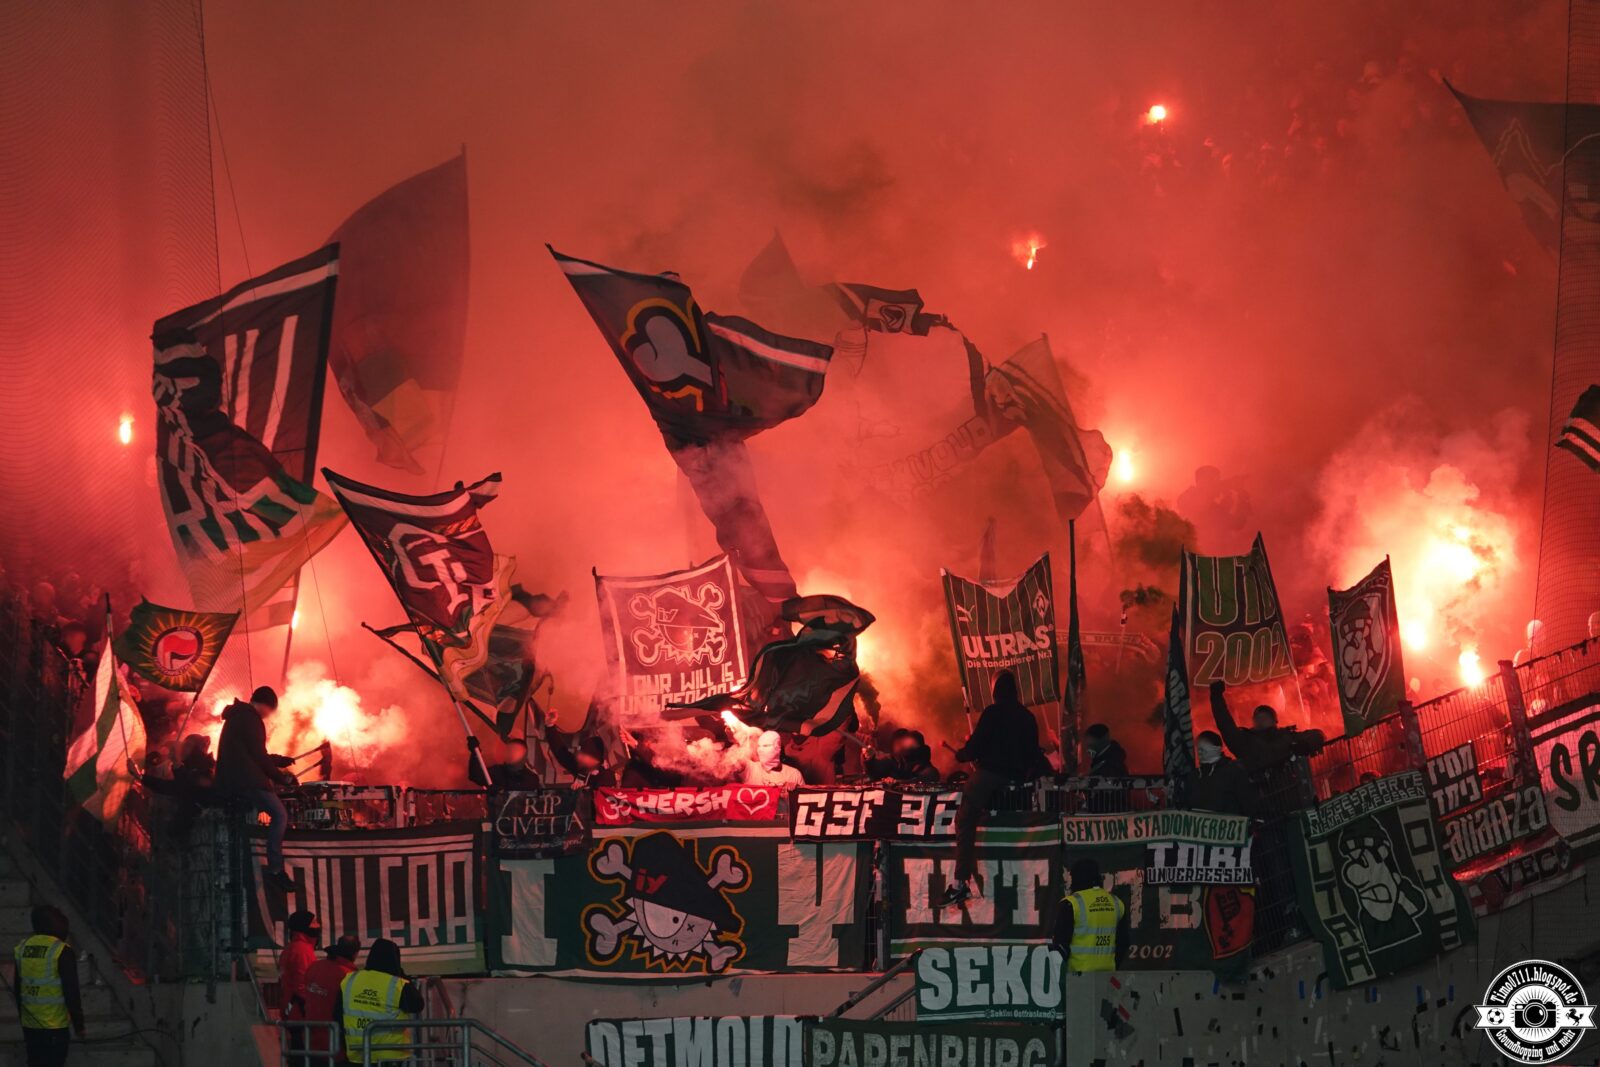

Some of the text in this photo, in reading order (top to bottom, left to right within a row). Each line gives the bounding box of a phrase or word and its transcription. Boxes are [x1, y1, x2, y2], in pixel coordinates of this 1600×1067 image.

[962, 625, 1051, 659] ULTRAS
[1194, 621, 1291, 687] 2002
[633, 661, 734, 695] OUR WILL IS
[967, 660, 981, 668] Die
[523, 794, 562, 815] RIP
[636, 789, 733, 816] HERSH
[496, 811, 584, 837] CIVETTA
[1066, 814, 1245, 845] SEKTION STADIONVERBOT
[1444, 785, 1548, 863] alianza
[1147, 867, 1254, 884] UNVERGESSEN
[904, 858, 1050, 926] INT
[1096, 936, 1111, 947] 2265
[1128, 944, 1175, 959] 2002
[918, 945, 1063, 1010] SEKO
